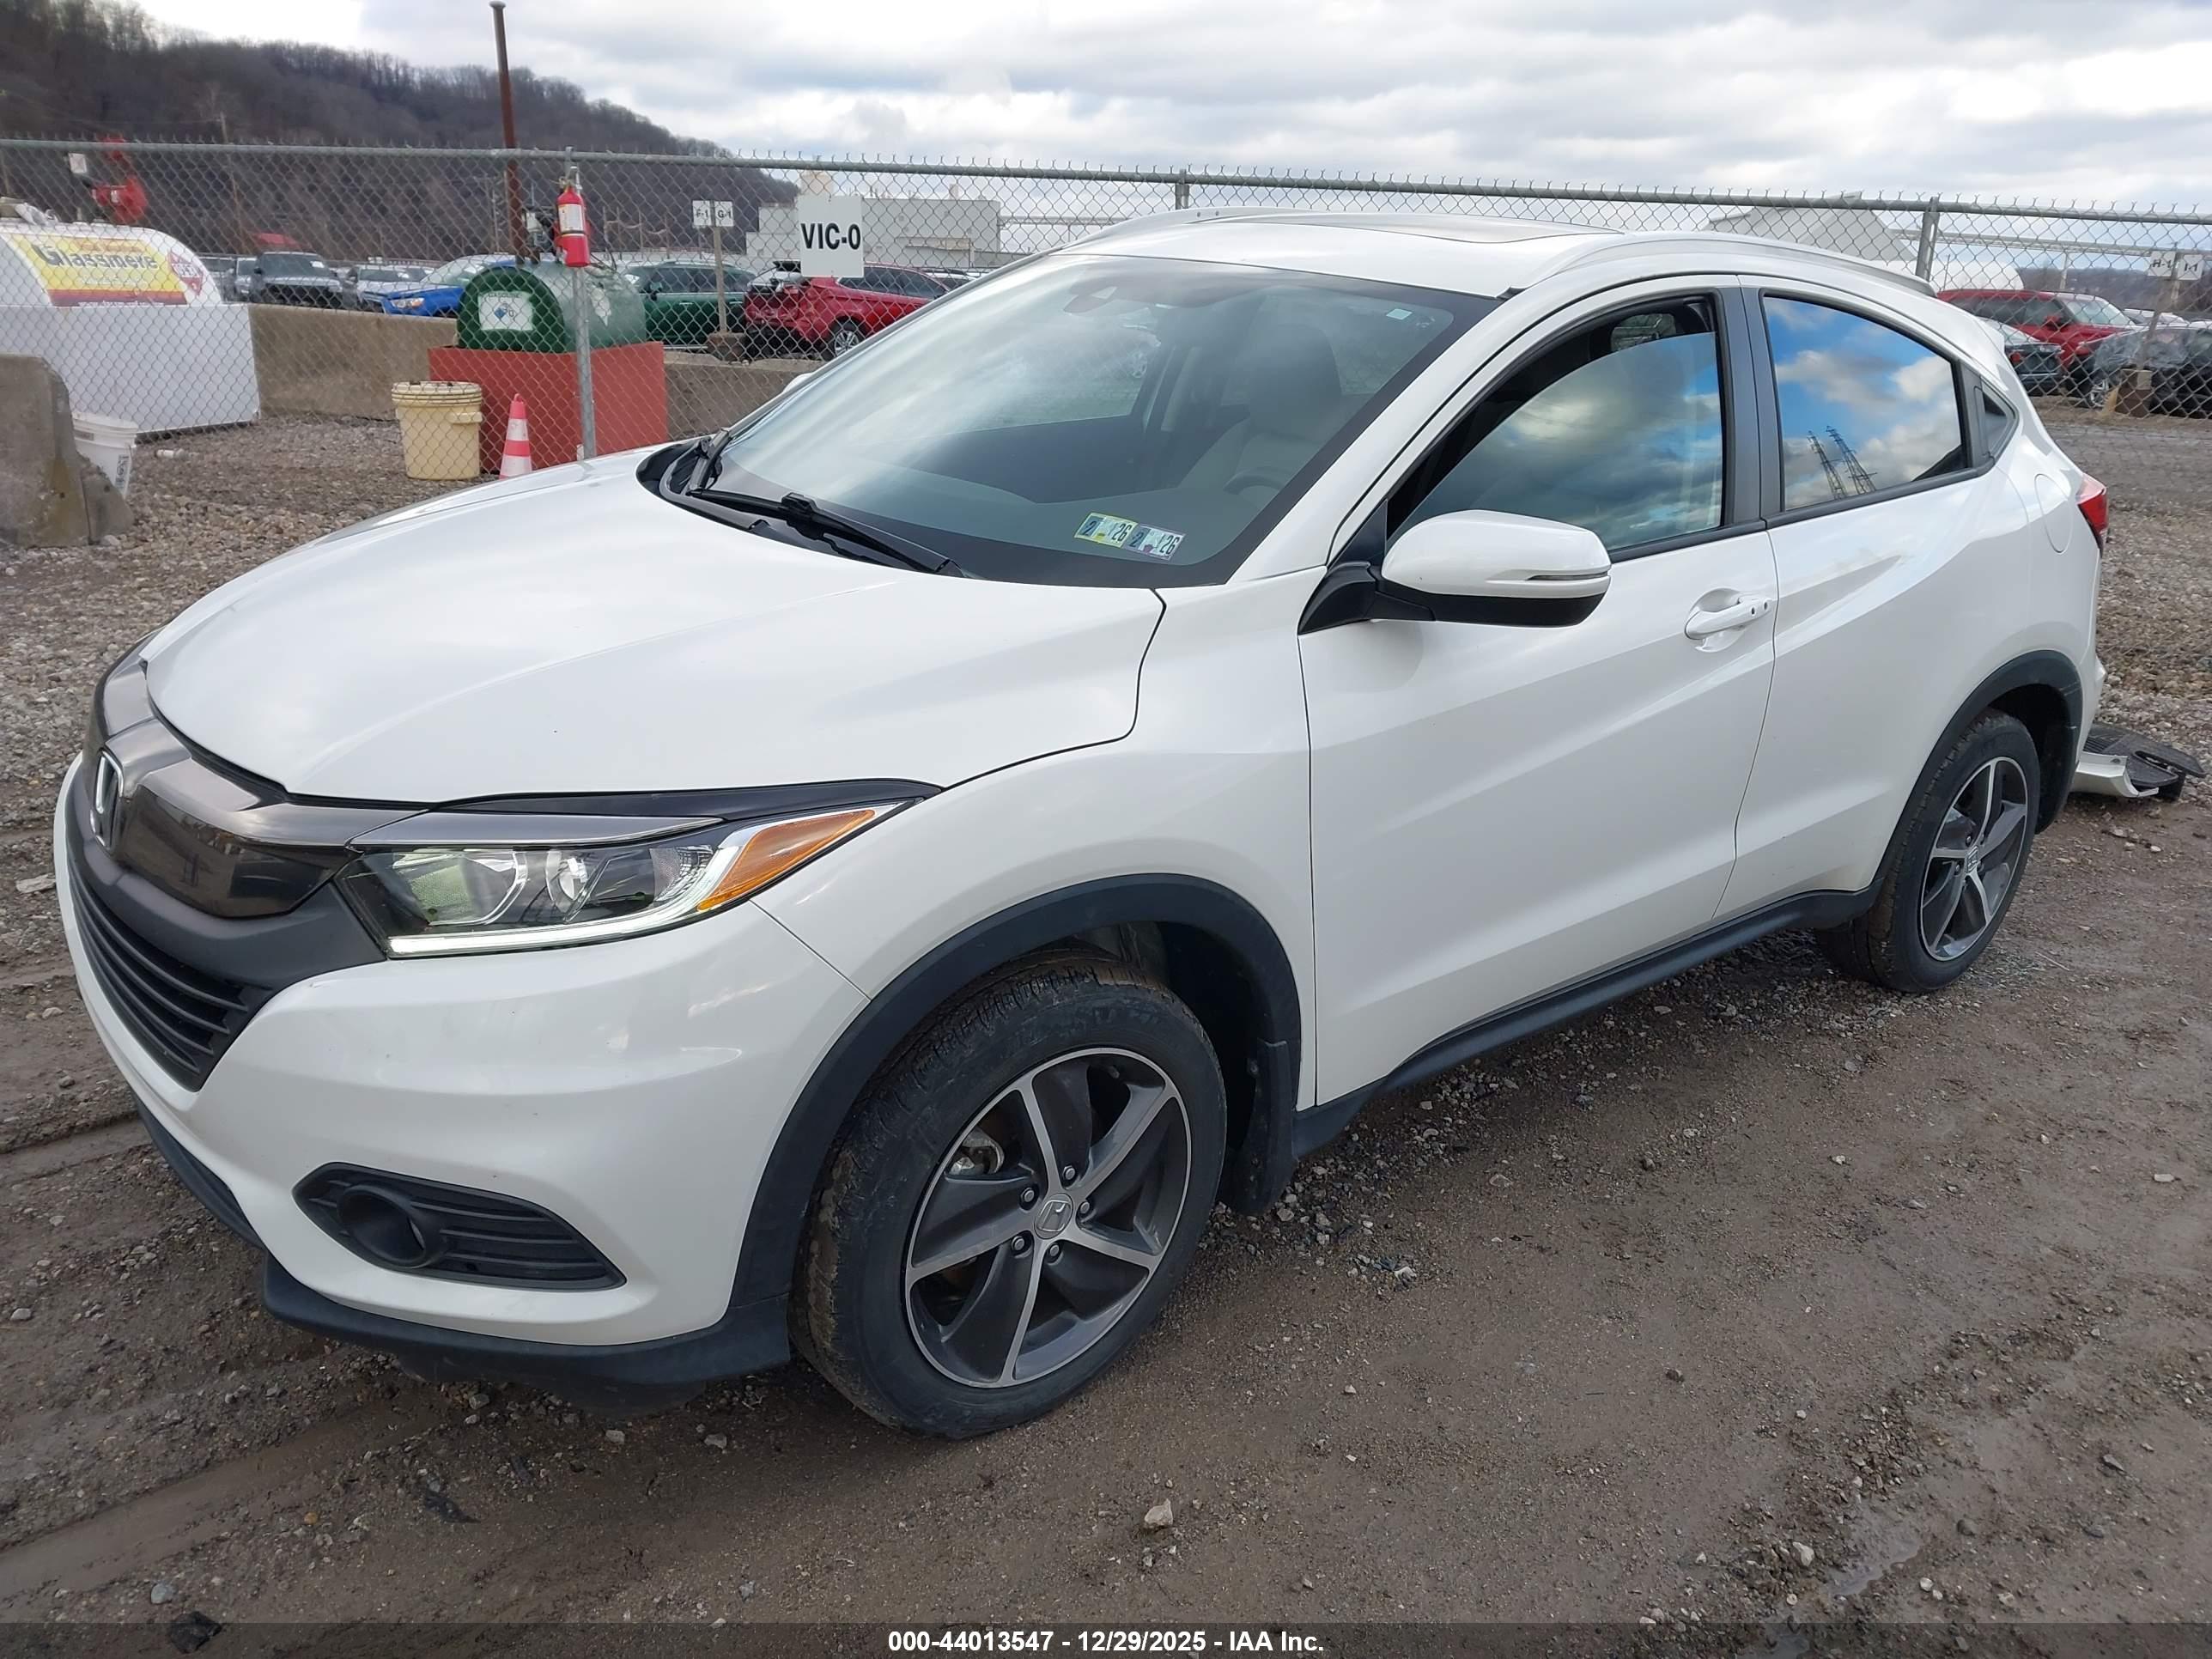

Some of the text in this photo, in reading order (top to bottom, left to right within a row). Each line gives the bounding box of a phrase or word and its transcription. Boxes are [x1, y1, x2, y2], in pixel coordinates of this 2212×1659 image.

[31, 244, 157, 268] Glassmere
[1083, 520, 1133, 542] 2 26
[1129, 532, 1180, 555] 2 26
